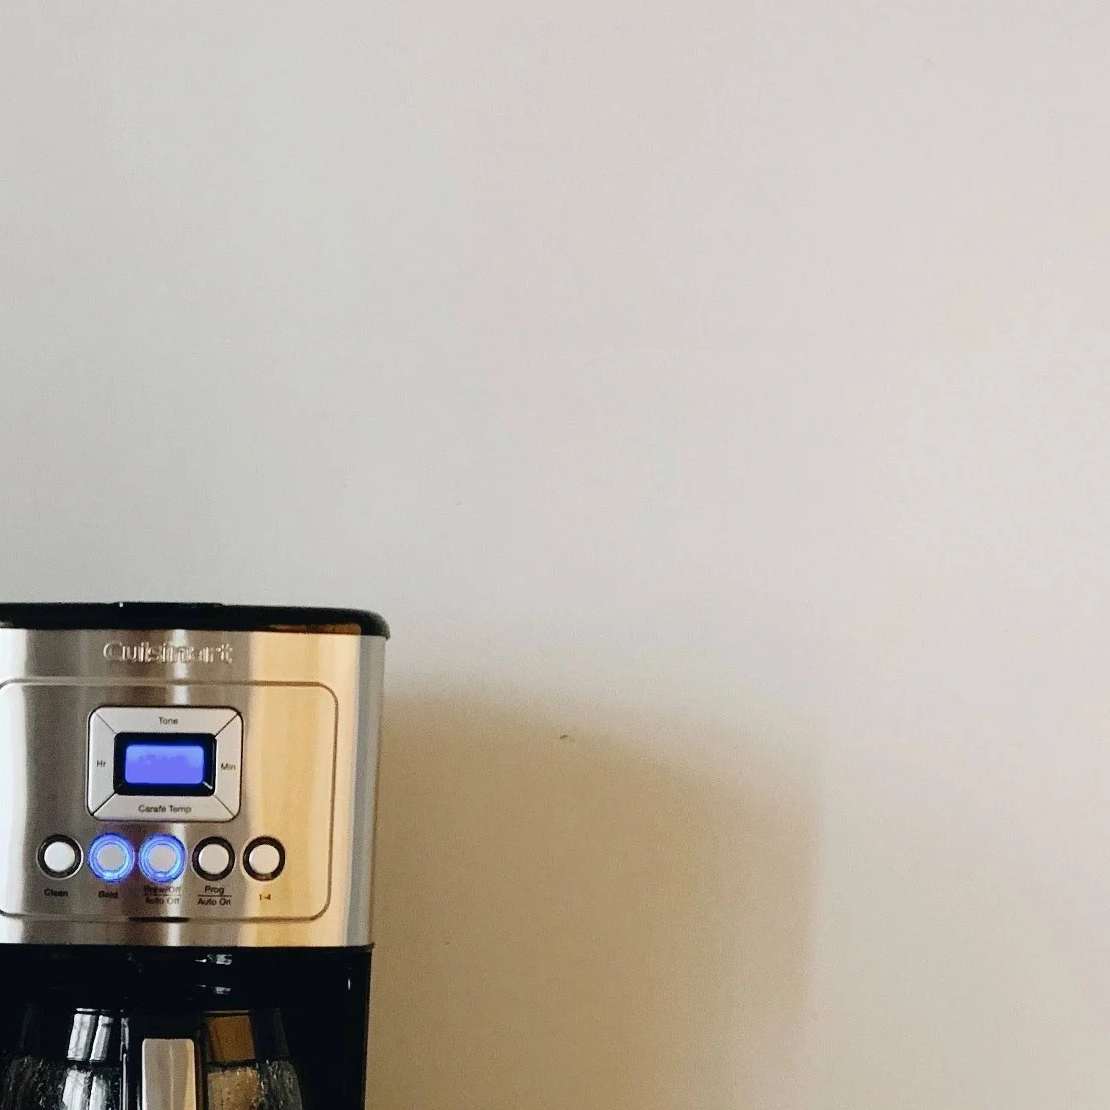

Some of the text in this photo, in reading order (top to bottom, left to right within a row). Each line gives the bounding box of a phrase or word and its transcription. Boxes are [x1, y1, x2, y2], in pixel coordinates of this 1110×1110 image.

[103, 641, 233, 663] Cuisinart
[158, 716, 179, 725] Tone
[96, 760, 107, 768] Hr
[220, 762, 236, 771] Min
[138, 804, 192, 814] Carafe Temp
[44, 888, 69, 898] Clean
[204, 885, 225, 896] Prog
[145, 896, 181, 905] Auto Off
[197, 897, 231, 906] Auto On
[259, 893, 271, 901] 1-4
